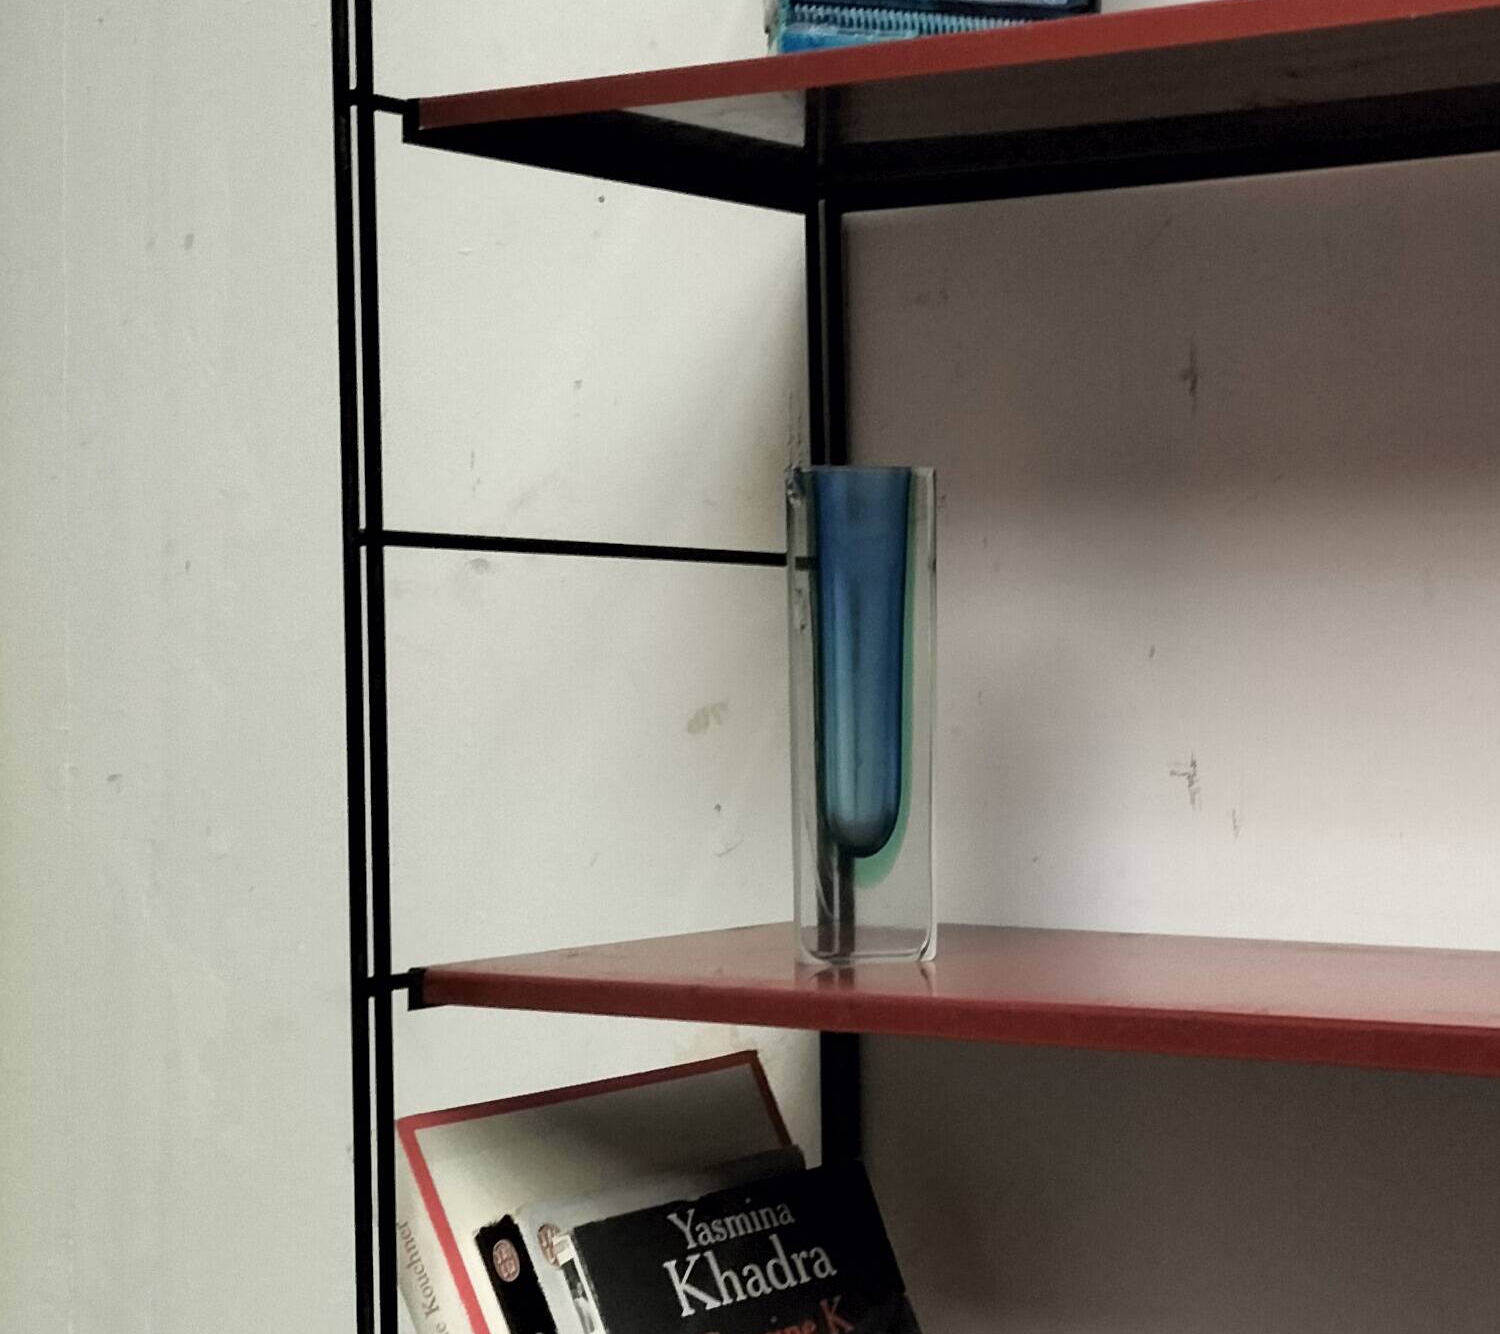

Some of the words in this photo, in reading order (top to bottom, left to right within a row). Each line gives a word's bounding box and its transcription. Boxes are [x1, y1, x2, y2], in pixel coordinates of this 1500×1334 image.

[667, 1197, 796, 1250] Yasmina
[396, 1220, 440, 1319] Kouchner
[663, 1233, 838, 1317] Khadra
